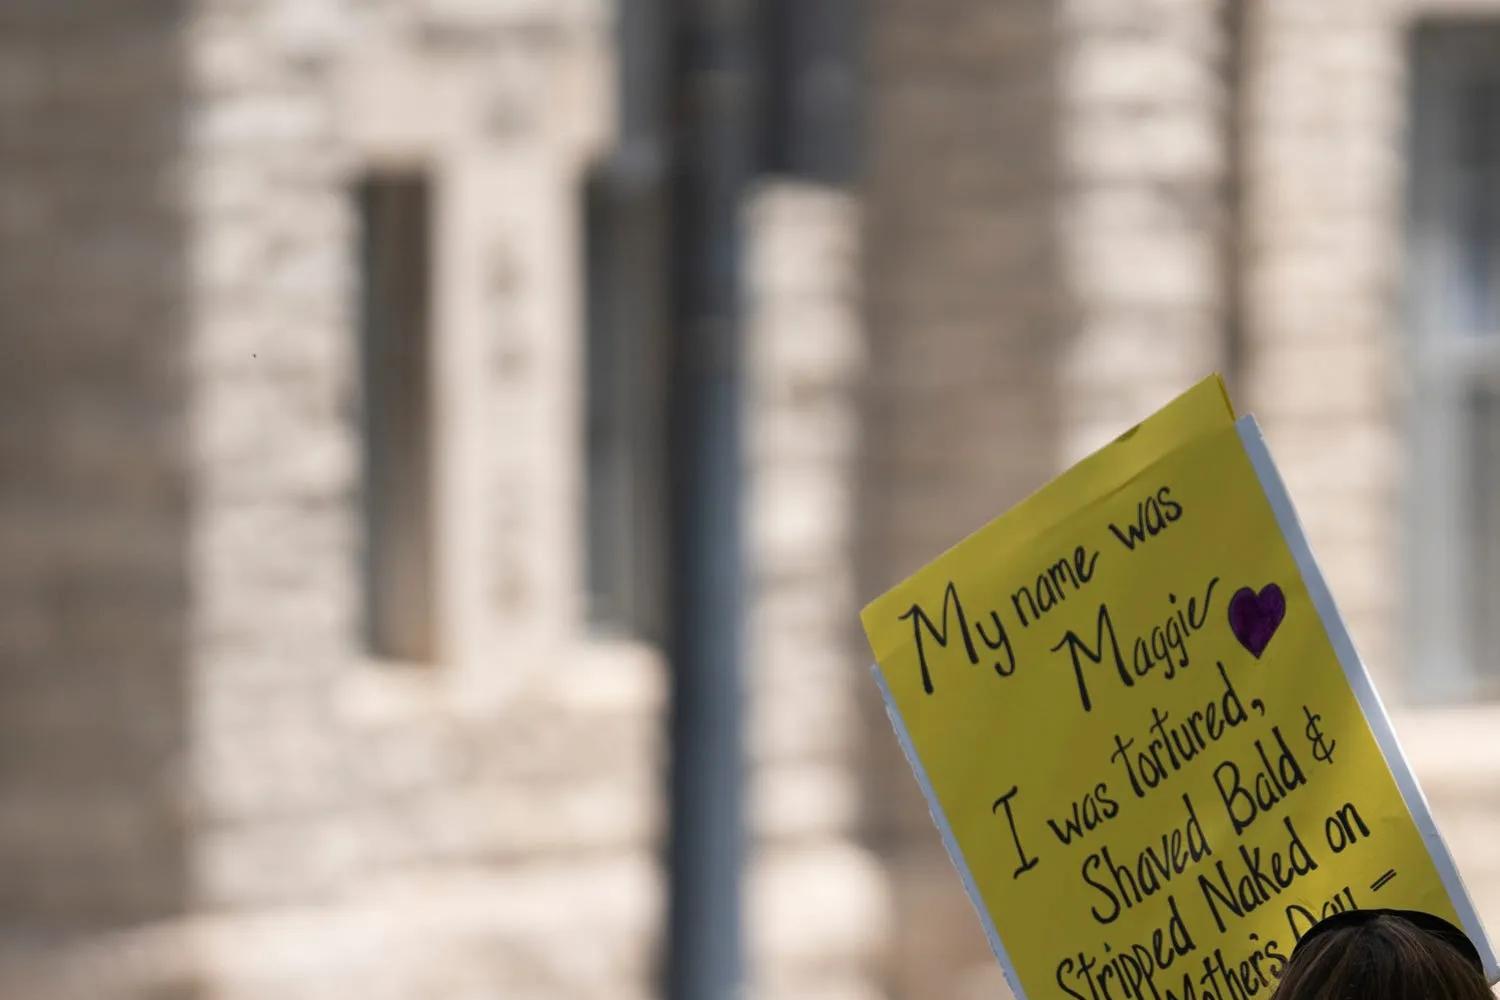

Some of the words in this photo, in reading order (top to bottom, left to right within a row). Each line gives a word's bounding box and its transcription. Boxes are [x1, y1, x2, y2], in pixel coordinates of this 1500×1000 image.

[898, 580, 1016, 694] My
[1010, 545, 1099, 627] name
[1109, 486, 1183, 550] was
[1050, 576, 1220, 711] Maggie
[992, 786, 1040, 880] I
[1047, 782, 1120, 846] was
[1112, 661, 1265, 797] tortured,
[1081, 793, 1212, 925] Shaved
[1213, 727, 1306, 834] Bald
[1303, 704, 1336, 764] &
[1199, 817, 1318, 932] Naked
[1325, 802, 1371, 853] on
